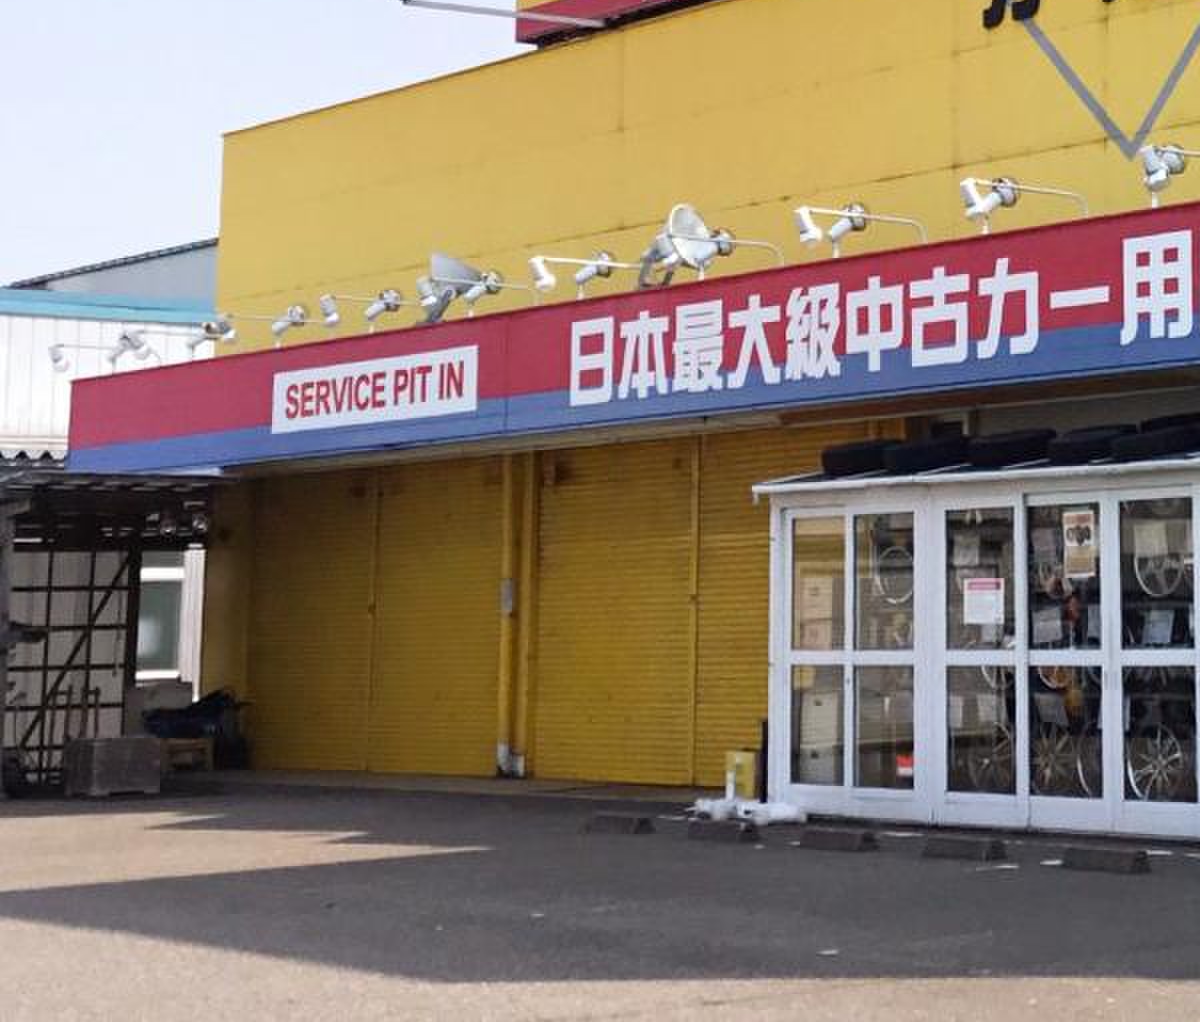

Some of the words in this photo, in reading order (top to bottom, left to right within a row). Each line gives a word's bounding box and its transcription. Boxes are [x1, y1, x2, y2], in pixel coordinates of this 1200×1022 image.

[285, 371, 387, 420] SERVICE
[393, 365, 434, 407] PIT
[438, 360, 465, 401] IN
